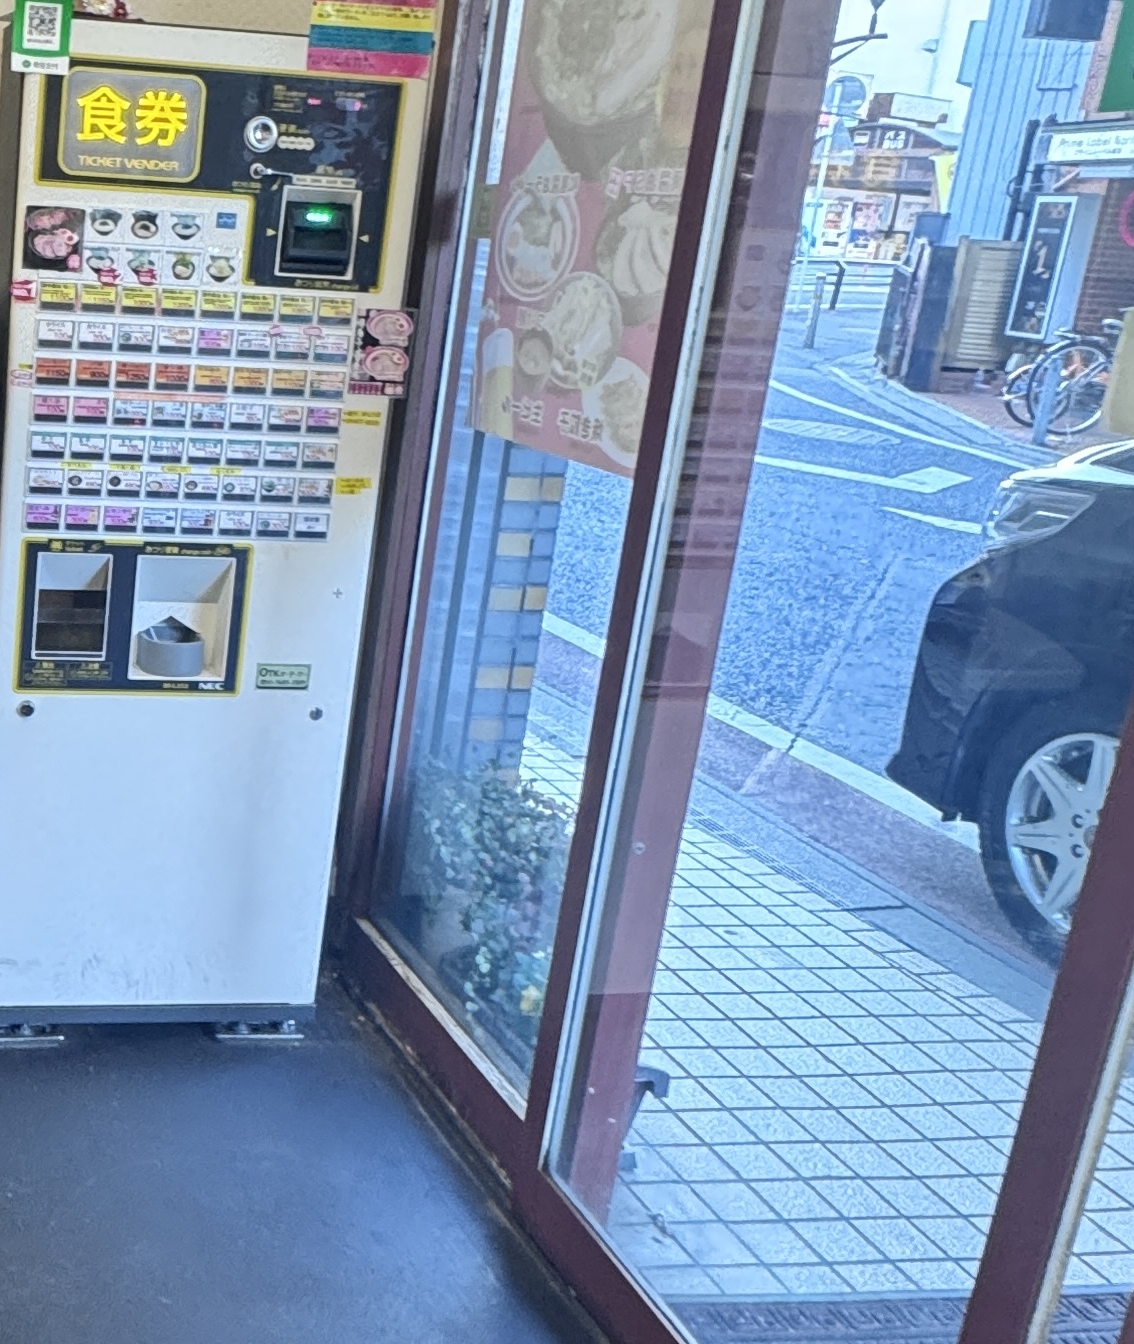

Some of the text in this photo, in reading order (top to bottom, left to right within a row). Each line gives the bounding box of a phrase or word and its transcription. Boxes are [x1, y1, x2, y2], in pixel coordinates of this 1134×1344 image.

[76, 85, 188, 147] 食券
[882, 139, 905, 150] BUS
[78, 155, 180, 172] TICKET VENDER
[198, 682, 225, 691] NEC
